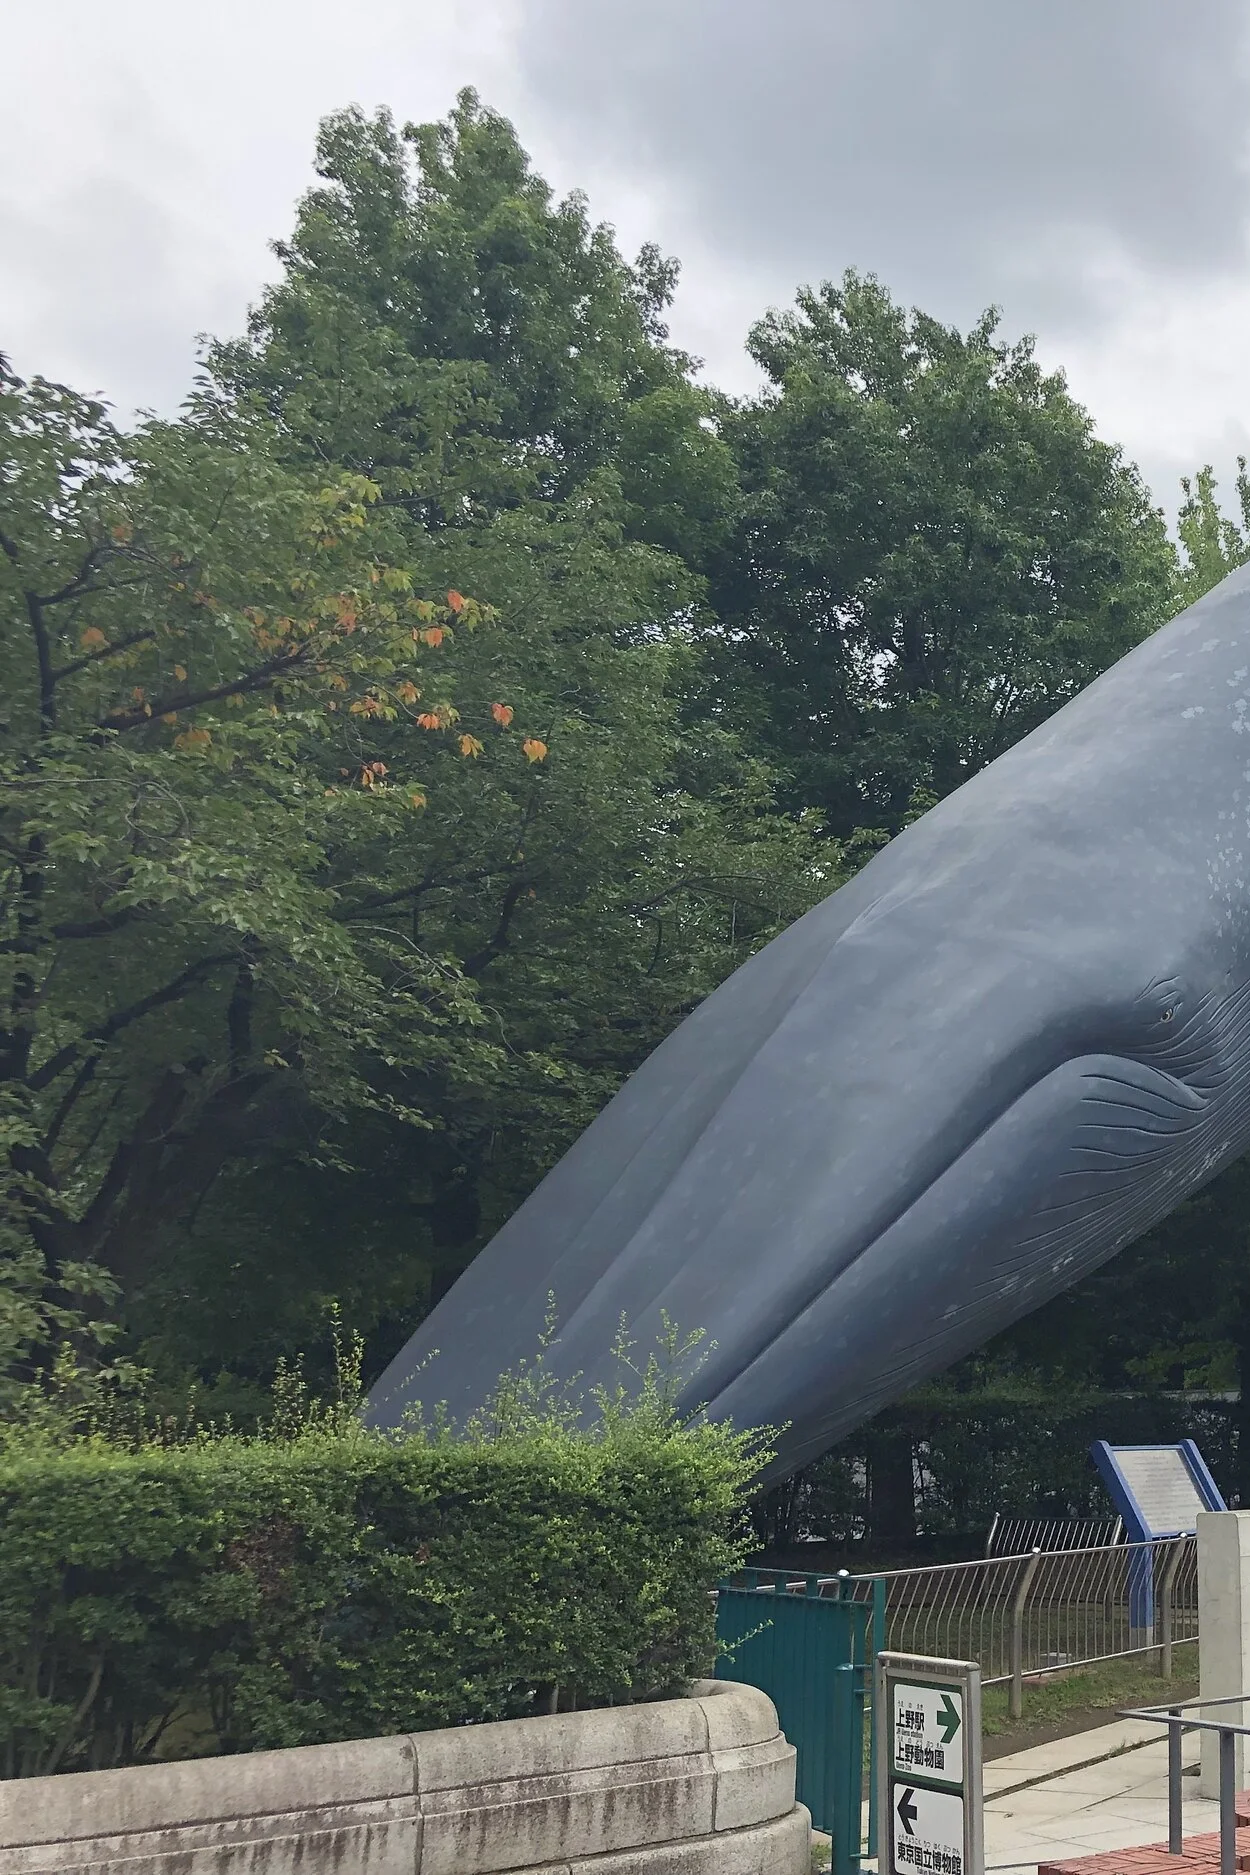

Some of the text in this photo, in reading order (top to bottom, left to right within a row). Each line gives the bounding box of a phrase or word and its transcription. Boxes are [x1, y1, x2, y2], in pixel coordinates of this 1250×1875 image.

[896, 1708, 925, 1731] 上野駅
[896, 1741, 944, 1770] 上野動物園
[897, 1841, 962, 1875] 東京国立博物館
